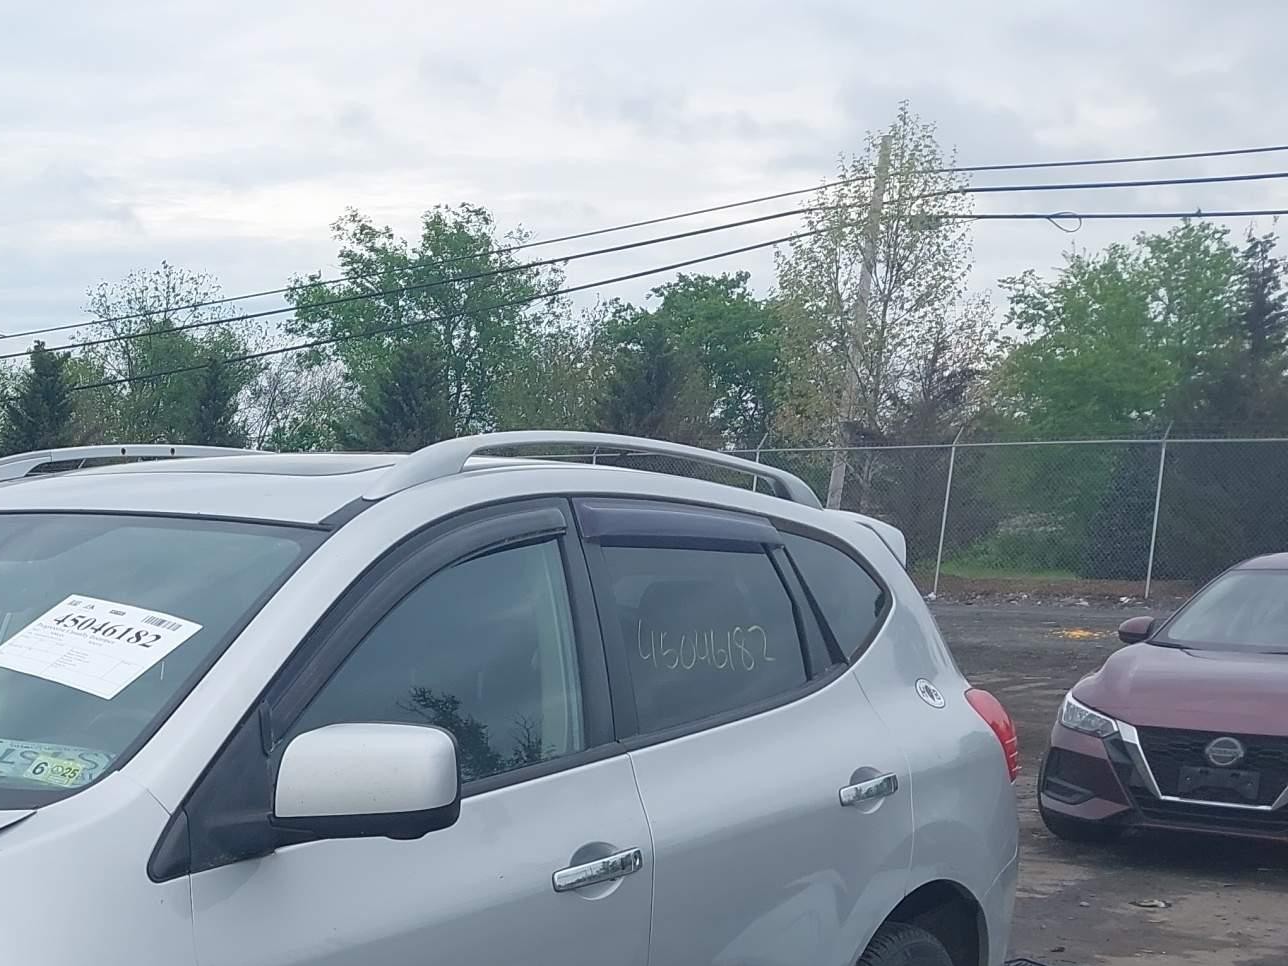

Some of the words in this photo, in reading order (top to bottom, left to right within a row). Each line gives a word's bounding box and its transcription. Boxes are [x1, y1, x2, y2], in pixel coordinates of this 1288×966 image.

[53, 612, 162, 648] 45046182
[637, 618, 776, 671] 45046182
[32, 761, 49, 776] 6
[60, 766, 80, 780] 25
